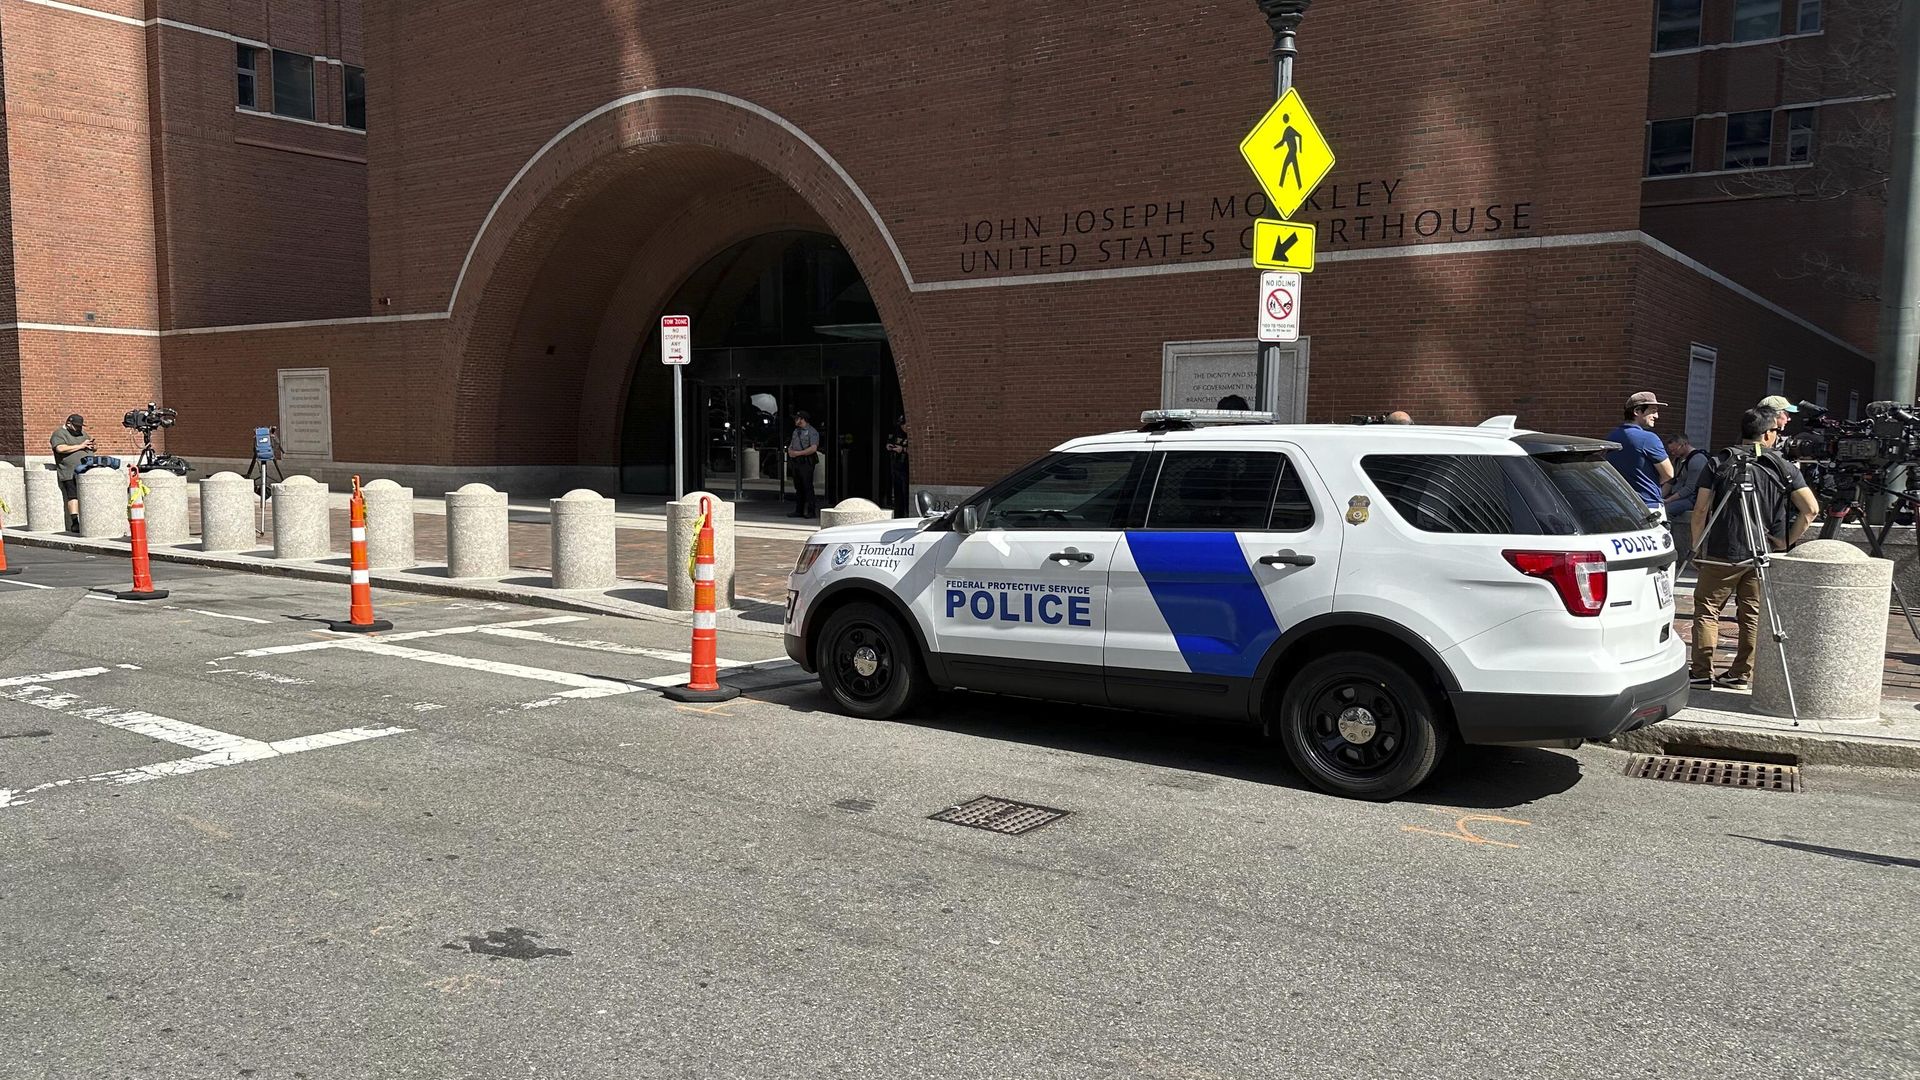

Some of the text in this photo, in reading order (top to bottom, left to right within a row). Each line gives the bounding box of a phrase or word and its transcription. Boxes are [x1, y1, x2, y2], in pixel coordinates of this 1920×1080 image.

[962, 179, 1401, 245] JOHN JOSEPH MOKLEY
[961, 202, 1531, 273] UNITED STATES CRTHOUSE
[1202, 383, 1244, 391] GOVERNMENT
[859, 544, 915, 556] Homeland
[1611, 535, 1658, 555] POLICE
[854, 556, 900, 572] Security
[946, 580, 1090, 595] FEDERAL PROTECTIVE SERVICE
[946, 589, 1091, 627] POLICE
